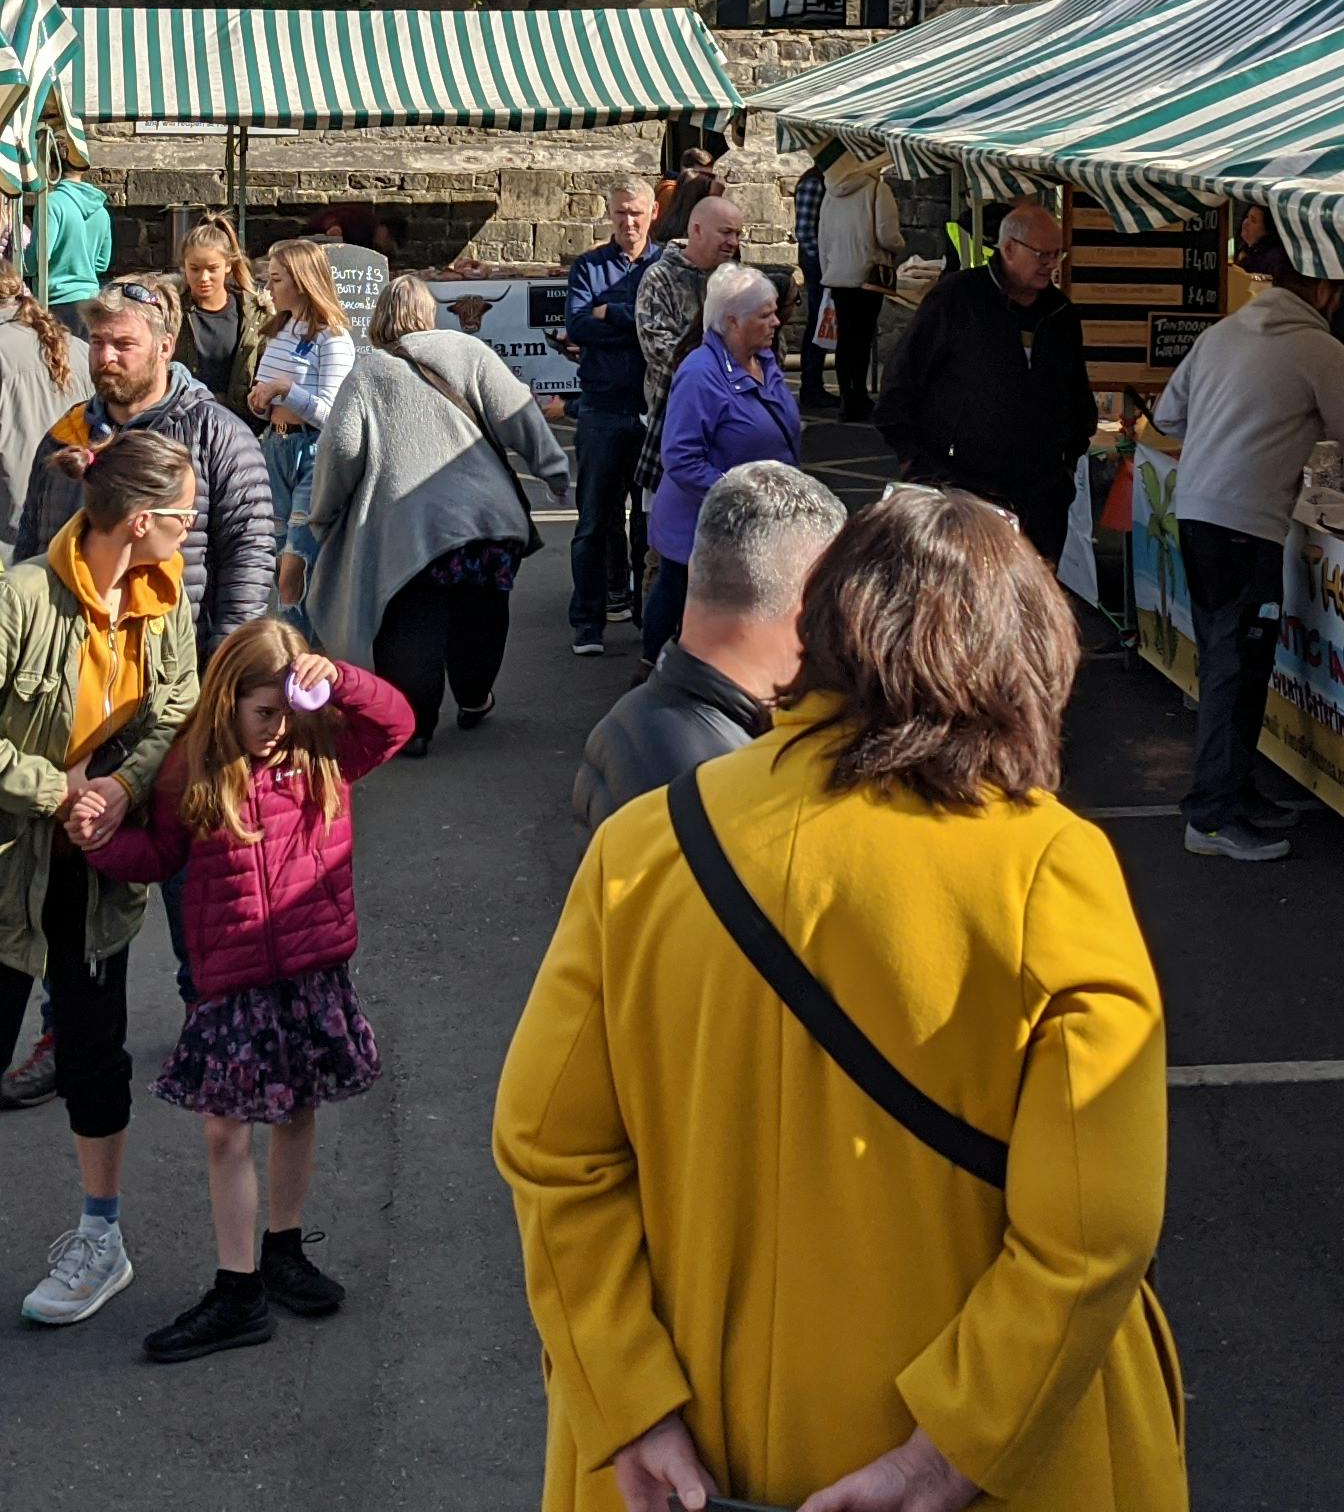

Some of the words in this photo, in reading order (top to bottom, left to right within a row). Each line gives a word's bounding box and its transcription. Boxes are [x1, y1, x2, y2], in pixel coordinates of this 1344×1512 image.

[366, 266, 384, 283] £3
[336, 283, 362, 295] BUTTY
[365, 282, 380, 295] £3
[545, 314, 567, 323] LOC
